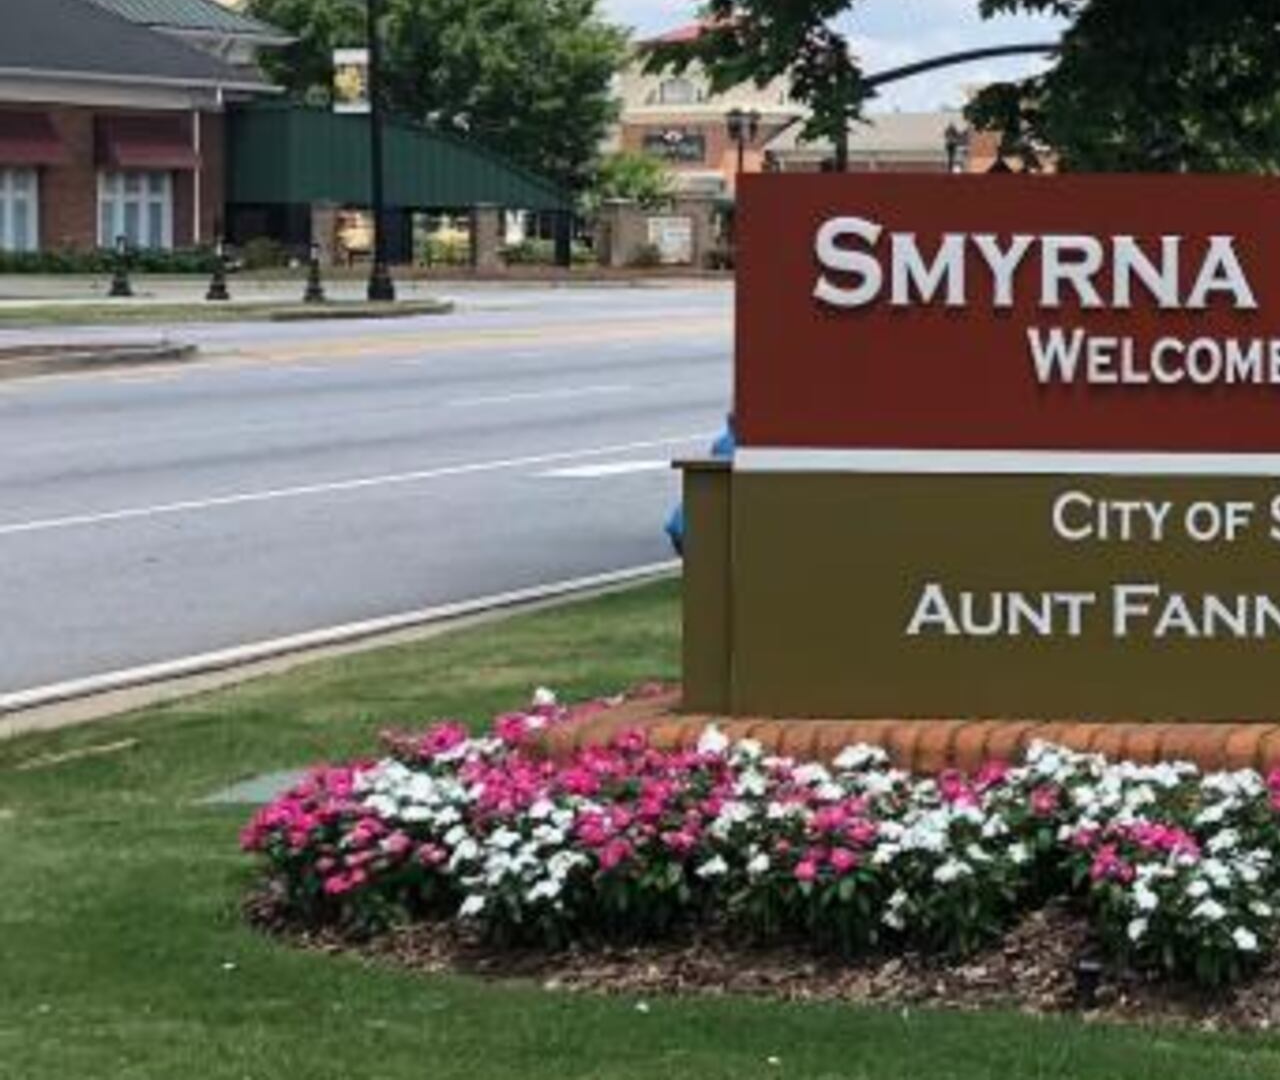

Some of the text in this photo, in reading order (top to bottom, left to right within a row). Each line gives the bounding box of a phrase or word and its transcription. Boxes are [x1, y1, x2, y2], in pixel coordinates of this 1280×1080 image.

[813, 216, 1256, 309] SMYRNA
[1051, 491, 1173, 541] CITY
[1185, 501, 1254, 541] OF
[905, 584, 1096, 636] AUNT
